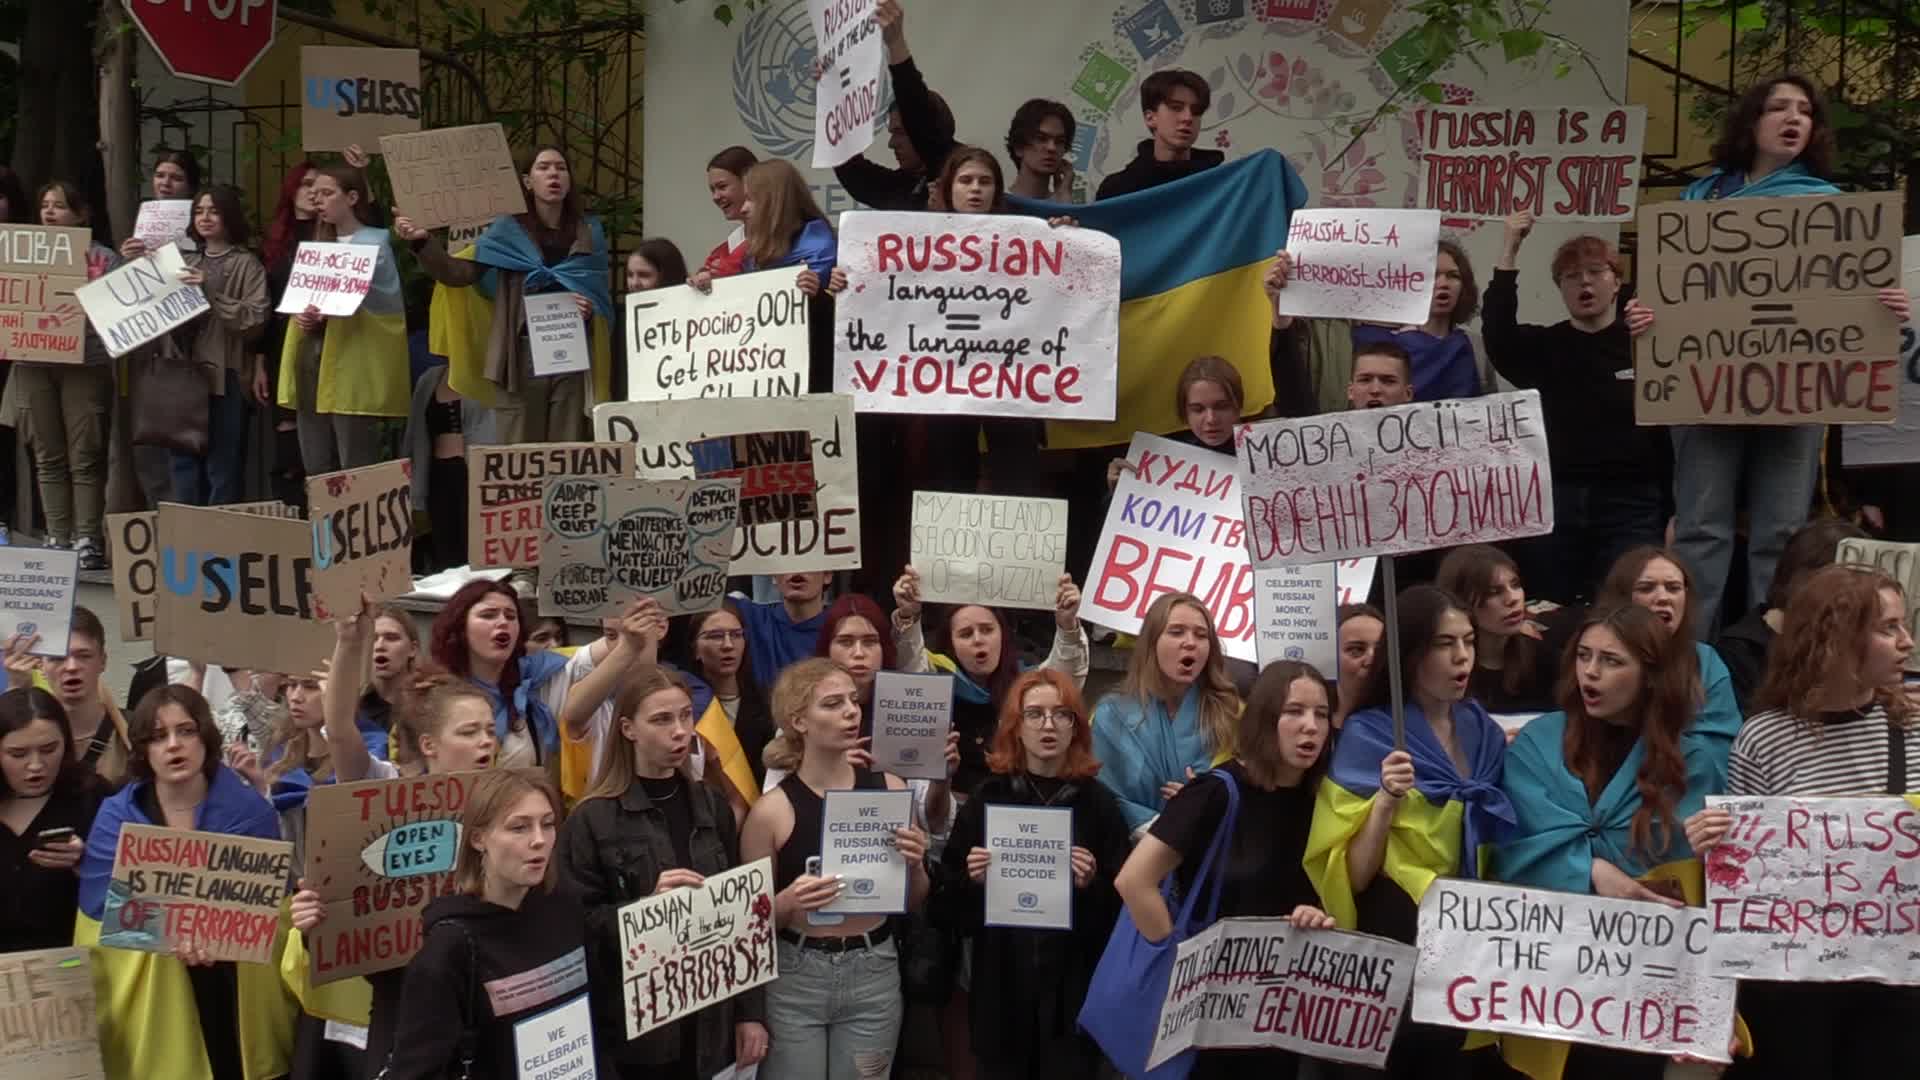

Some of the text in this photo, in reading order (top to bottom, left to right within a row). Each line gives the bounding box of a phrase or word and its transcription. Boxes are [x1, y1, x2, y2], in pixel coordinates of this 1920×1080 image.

[1601, 110, 1627, 144] A
[1554, 155, 1636, 216] STATE
[1658, 201, 1882, 255] RUSSIAN
[888, 274, 1032, 320] language
[846, 318, 1069, 367] the language of
[657, 351, 698, 388] Get
[1690, 358, 1898, 416] VIOLENCE
[1244, 421, 1355, 475] МОВА
[484, 447, 623, 481] RUSSIAN
[1136, 450, 1233, 500] КУДИ
[551, 503, 596, 520] KEEP
[692, 488, 736, 507] DETACH
[1380, 461, 1545, 542] ЗЛОЧИНИ
[312, 484, 413, 570] USELESS
[914, 494, 1053, 533] MY HOMELAND
[1120, 493, 1206, 541] КОЛИ
[1013, 531, 1066, 564] CAUSE
[23, 560, 44, 572] WE
[617, 567, 684, 590] CRUELTY
[976, 561, 1049, 605] RUZZIA
[1265, 578, 1323, 589] CELEBRATE
[1272, 592, 1316, 602] RUSSIAN
[3, 601, 55, 612] KILLING
[1262, 631, 1329, 641] THEY OWN US
[1271, 618, 1318, 629] AND HOW
[879, 699, 948, 712] CELEBRATE
[905, 687, 923, 698] WE
[885, 726, 937, 738] ECOCIDE
[887, 713, 937, 725] RUSSIAN
[858, 806, 879, 817] WE
[395, 823, 445, 846] OPEN
[829, 822, 905, 834] CELEBRATE
[1018, 823, 1039, 834] WE
[119, 833, 290, 881] RUSSIAN LANGUAGE
[390, 845, 437, 870] EYES
[841, 853, 889, 864] RAPING
[992, 838, 1065, 850] CELEBRATE
[1000, 853, 1056, 865] RUSSIAN
[128, 870, 282, 908] IS THE LANGUAGE
[1000, 868, 1057, 880] ECOCIDE
[1877, 866, 1899, 895] A
[622, 868, 764, 948] RUSSIAN WORD
[119, 901, 279, 949] OF TERRORISM
[1488, 936, 1552, 971] THE
[1577, 945, 1632, 976] DAY
[1162, 986, 1399, 1052] SUPPORTING GENOCIDE
[1447, 975, 1700, 1043] GENOCIDE
[547, 1026, 567, 1042] WE
[524, 1034, 589, 1071] CELEBRATE
